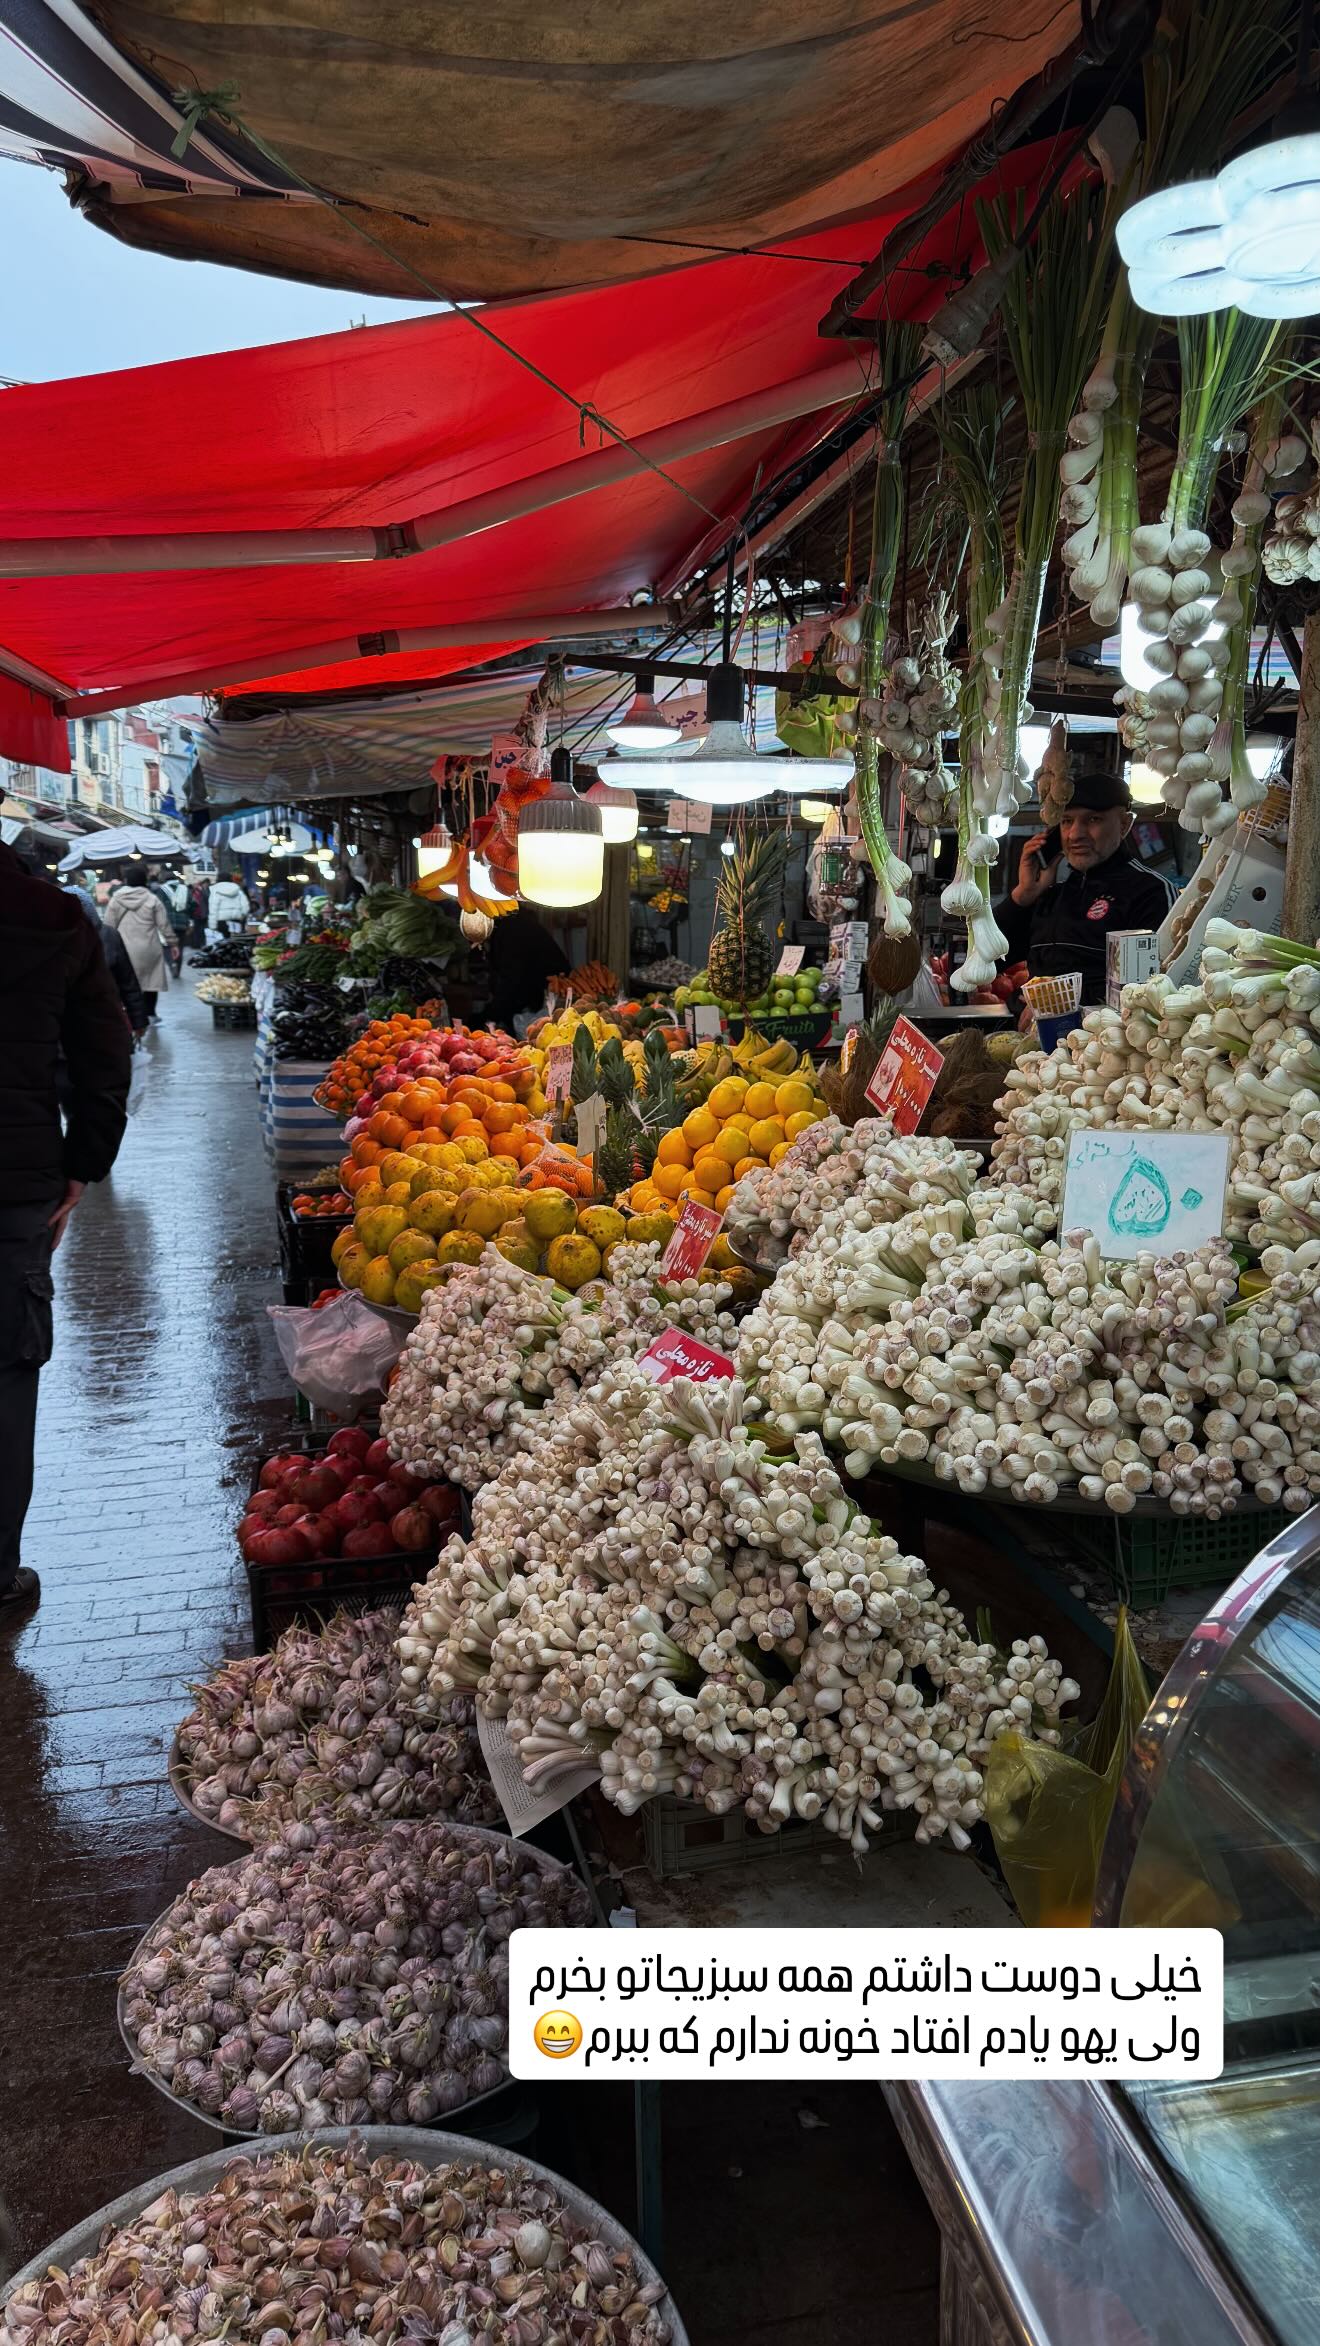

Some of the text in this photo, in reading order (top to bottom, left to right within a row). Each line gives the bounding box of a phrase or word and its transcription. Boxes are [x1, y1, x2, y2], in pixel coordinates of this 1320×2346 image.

[765, 1019, 815, 1038] Fruits
[890, 1030, 938, 1080] سیر تازه محلی
[1108, 1155, 1203, 1239] ۵۰
[655, 1343, 715, 1378] تازه محلی
